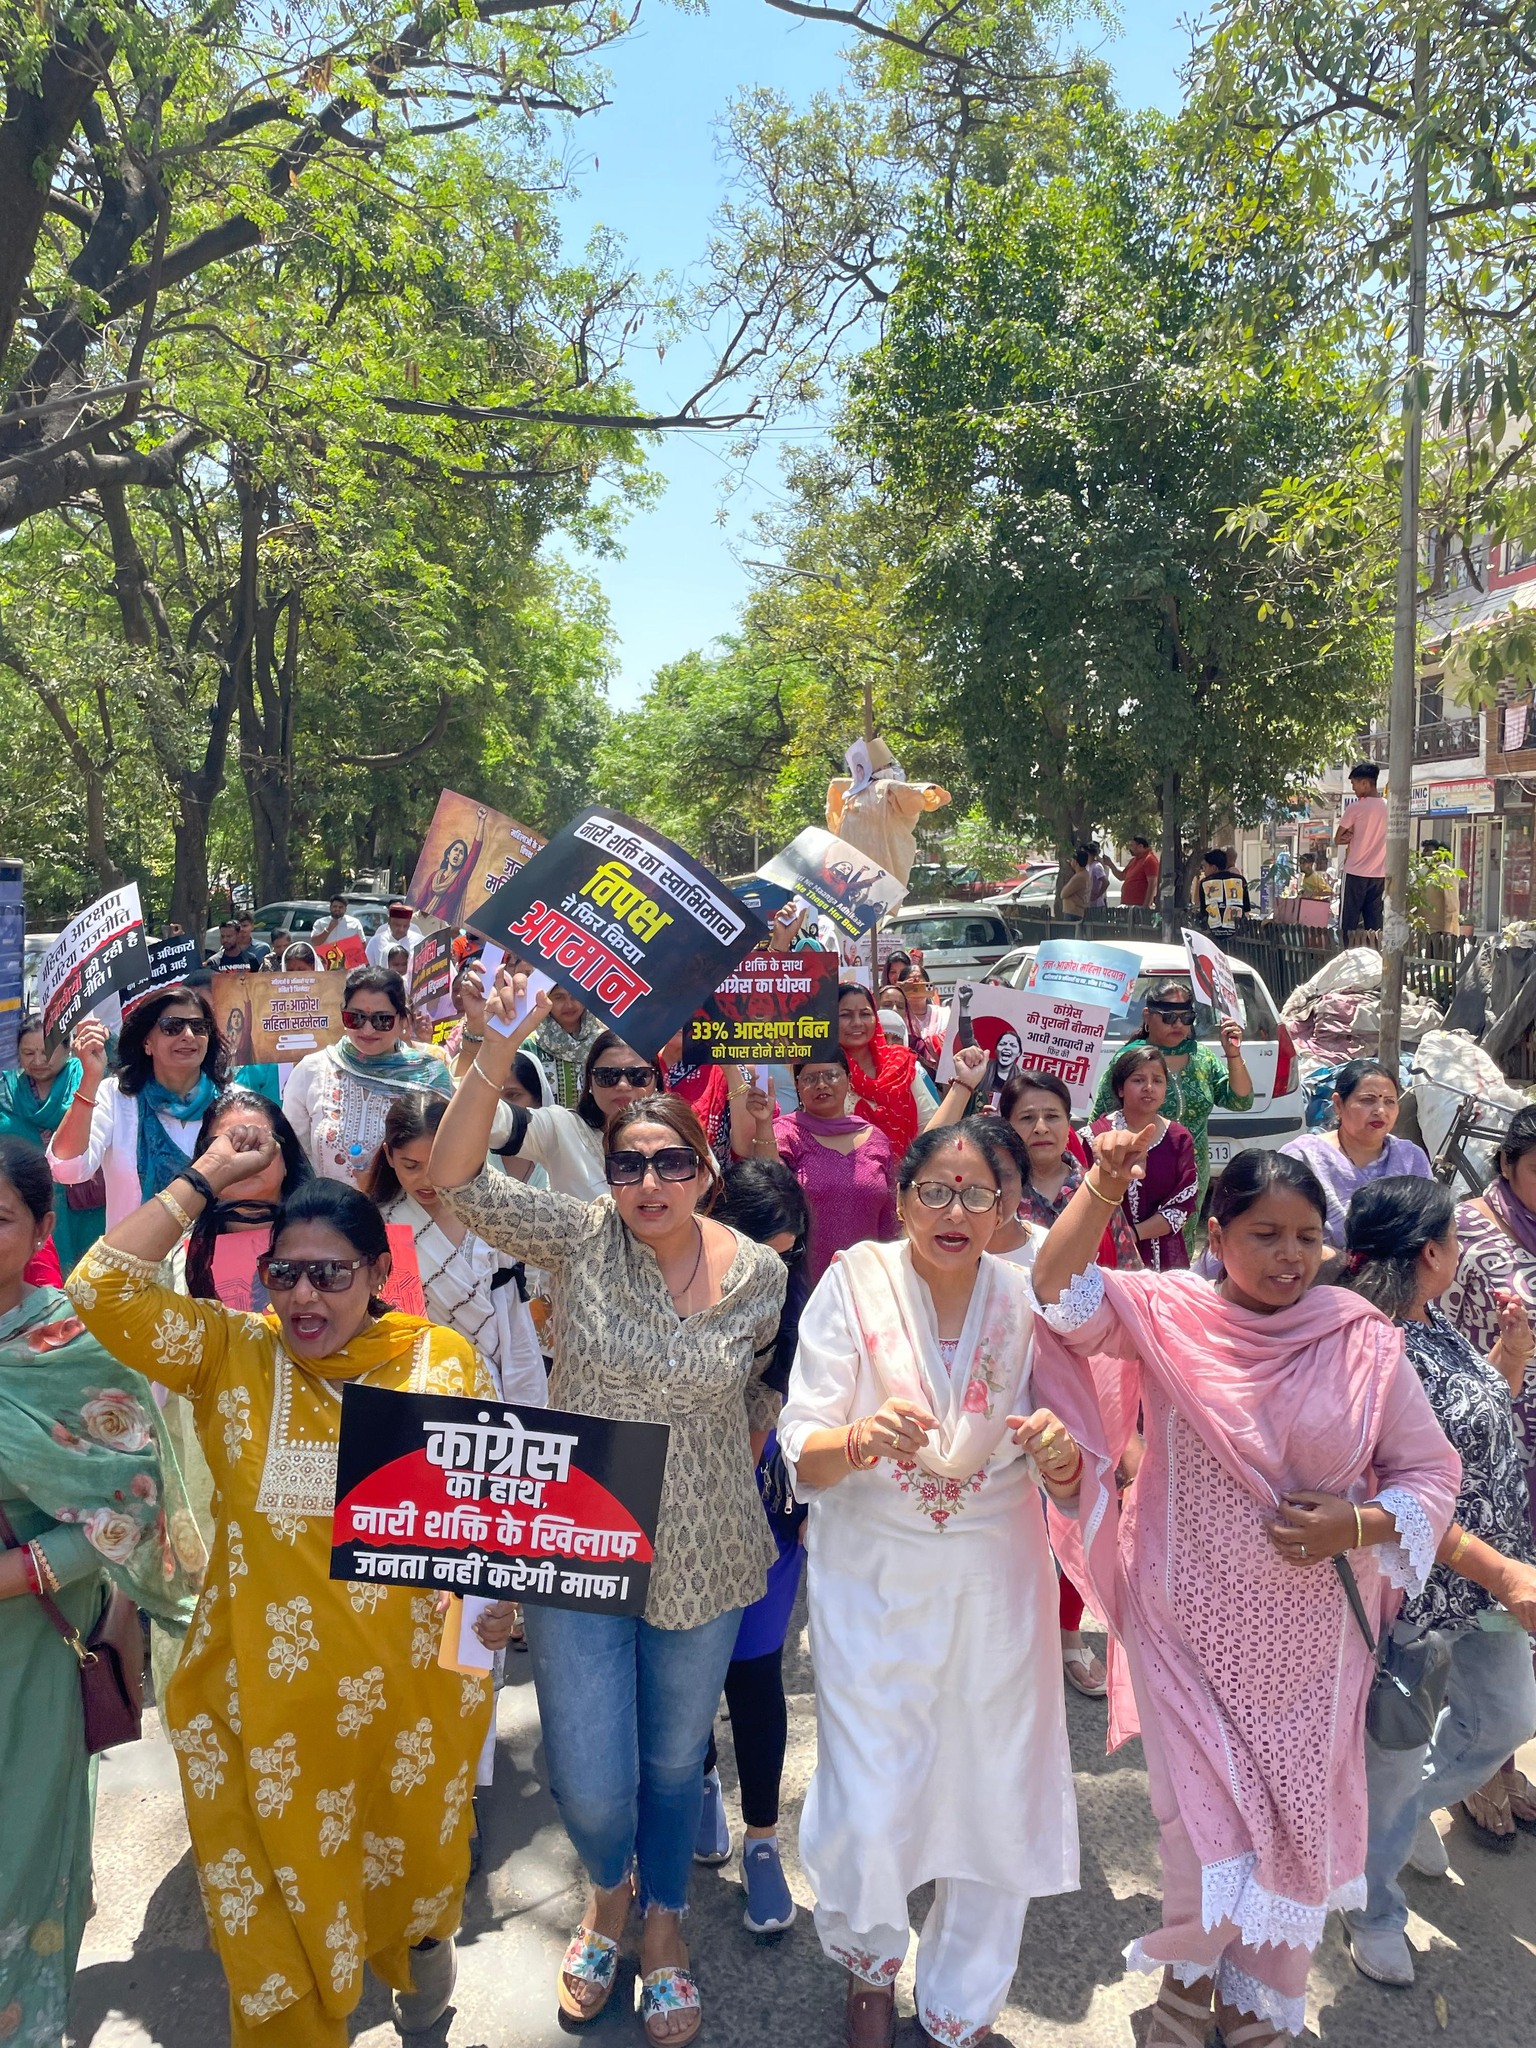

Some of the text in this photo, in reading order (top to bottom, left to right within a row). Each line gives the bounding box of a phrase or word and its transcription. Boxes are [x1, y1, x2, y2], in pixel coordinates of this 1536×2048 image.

[1412, 787, 1428, 800] INIC
[579, 821, 612, 845] नारी
[606, 834, 644, 860] शक्ति
[638, 848, 664, 875] का
[658, 867, 738, 941] स्वाभिमान
[71, 893, 122, 943] आरक्षण
[579, 861, 674, 943] विपक्ष
[835, 902, 866, 928] Adhikaar
[51, 953, 77, 988] घटिया
[79, 907, 131, 953] राजनीति
[561, 892, 646, 965] ने फिर किया
[84, 955, 100, 980] की
[101, 938, 123, 964] रही
[126, 930, 139, 949] है
[508, 900, 653, 1018] अपमान
[744, 957, 768, 972] शक्ति
[769, 957, 780, 972] के
[781, 959, 804, 972] साथ
[754, 977, 774, 994] का
[775, 974, 812, 993] धोखा
[58, 995, 81, 1034] पुरानी
[262, 1013, 329, 1031] महिला सम्मेलन
[691, 1016, 831, 1040] 33% आरक्षण बिल
[1026, 1011, 1105, 1038] की पुरानी बीमारी
[1053, 1003, 1084, 1019] कांग्रेस
[711, 1042, 813, 1059] को पास होने से रोका
[1027, 1031, 1095, 1053] आधी आबादी से
[1046, 1045, 1070, 1058] फिर की
[422, 1411, 579, 1483] कांग्रेस
[444, 1470, 547, 1509] का हाथ,
[350, 1500, 642, 1559] नारी शक्ति के खिलाफ
[352, 1550, 630, 1600] जनता नहीं करेगी माफ।
